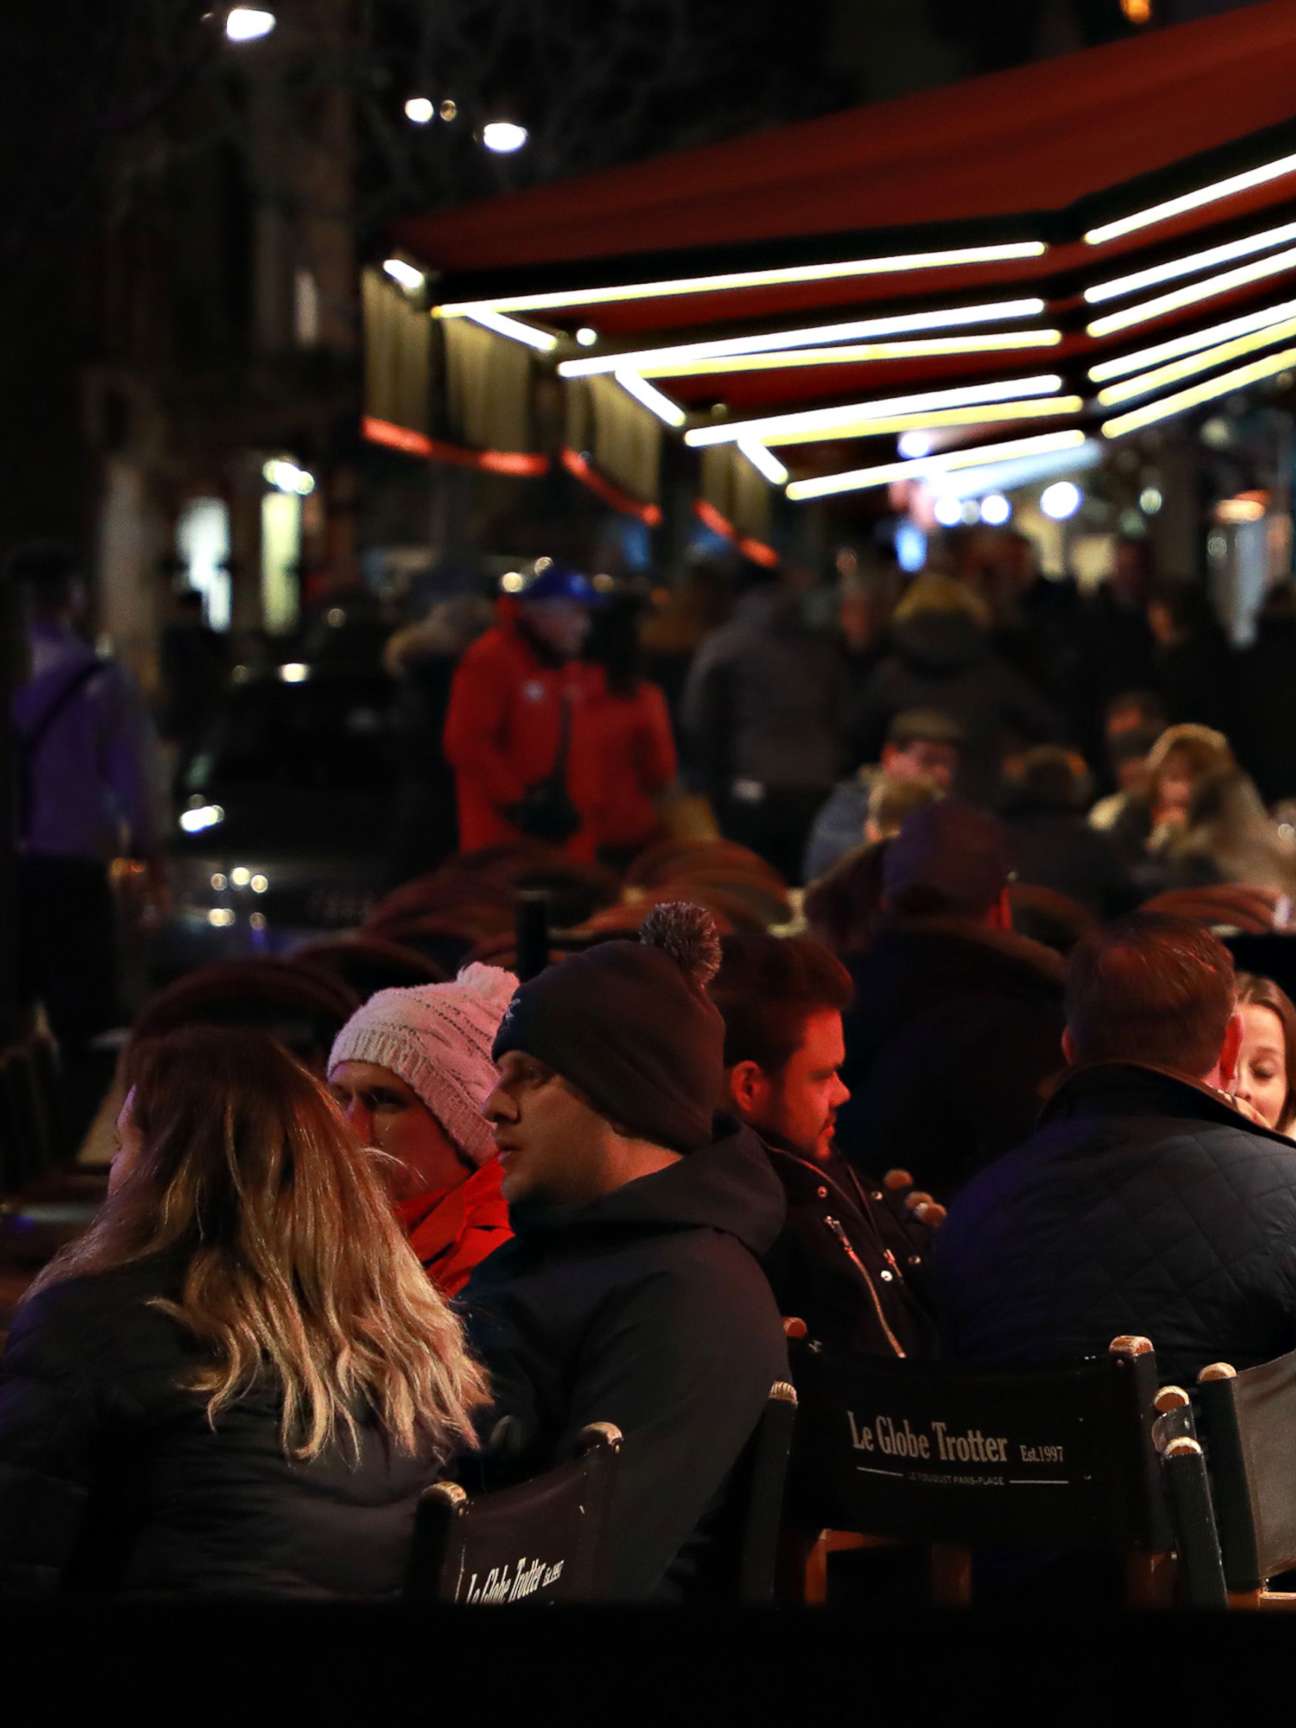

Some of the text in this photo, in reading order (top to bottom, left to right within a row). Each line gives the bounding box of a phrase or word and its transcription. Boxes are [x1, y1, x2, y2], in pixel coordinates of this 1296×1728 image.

[847, 1410, 1064, 1463] Le Globe Trotter Est.1997
